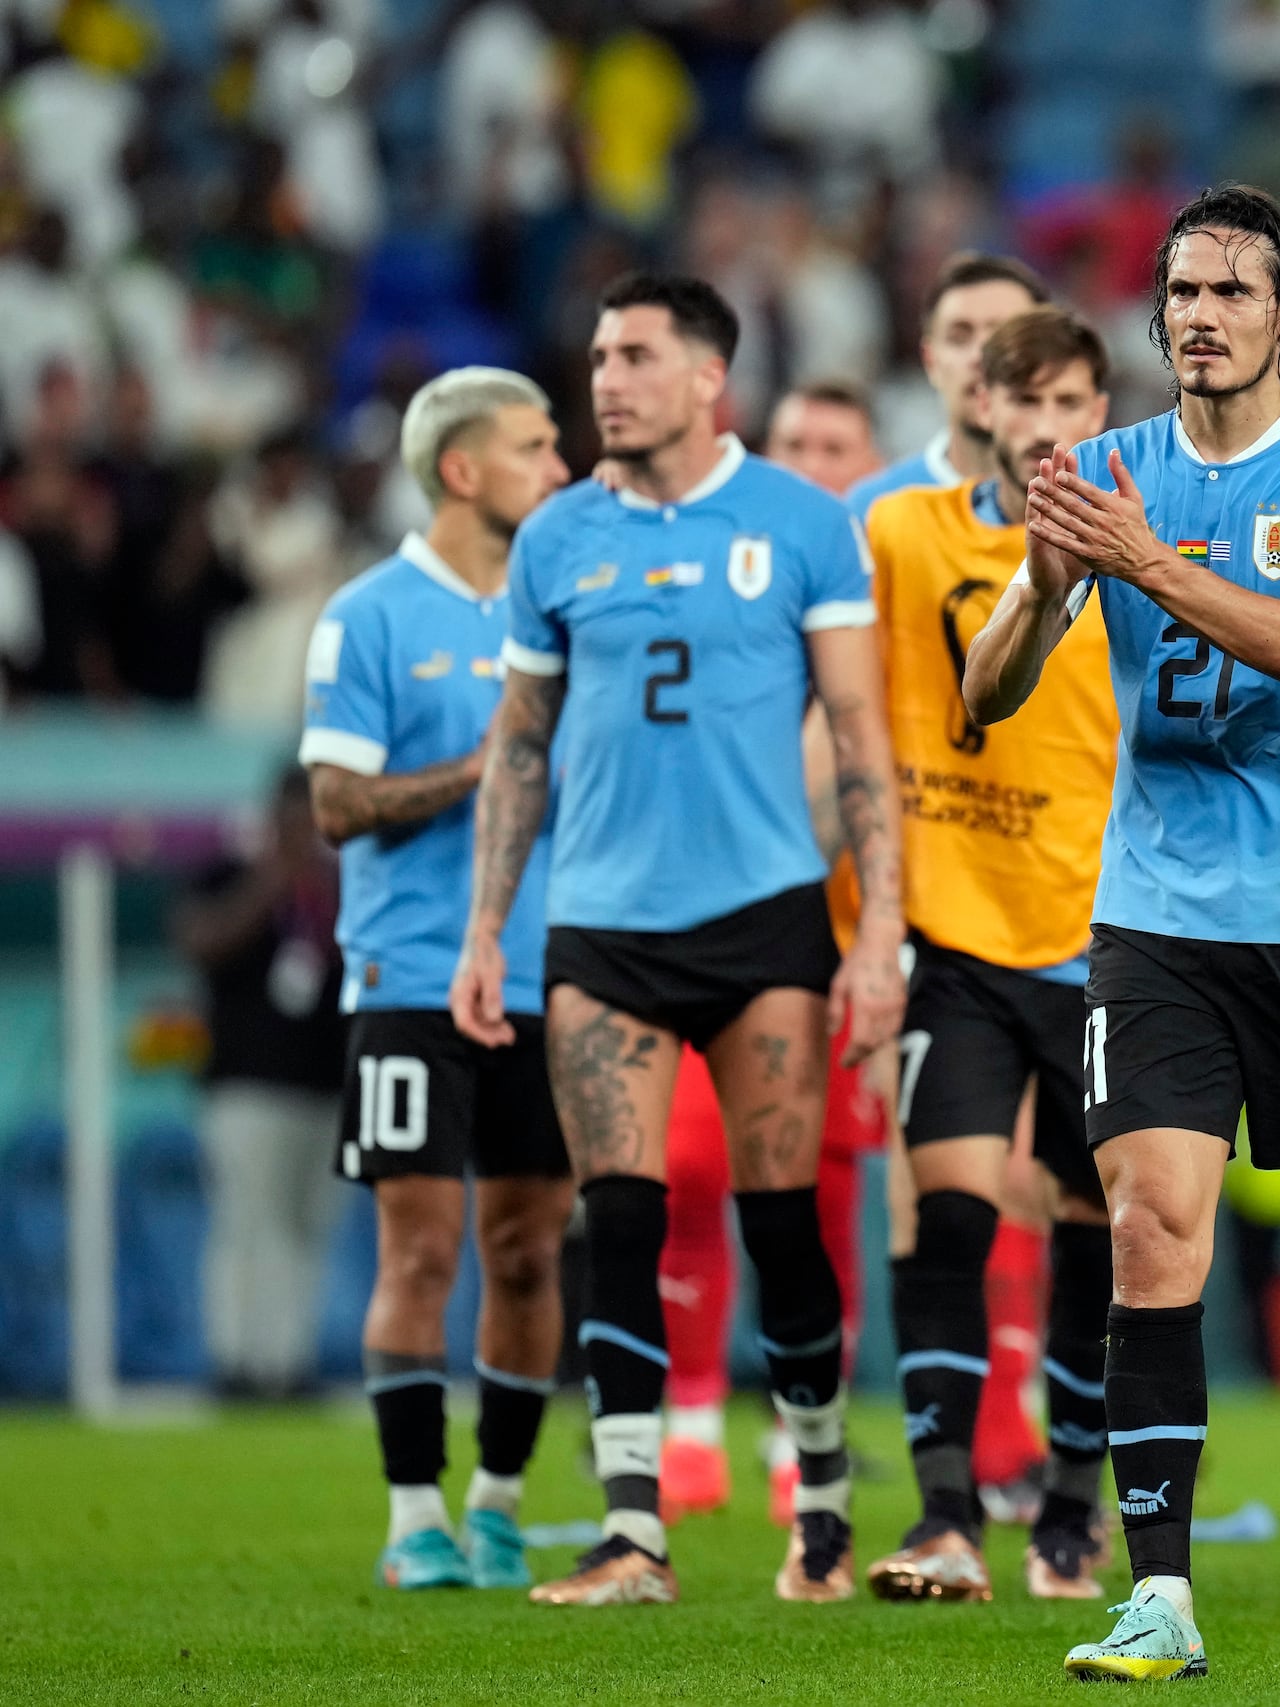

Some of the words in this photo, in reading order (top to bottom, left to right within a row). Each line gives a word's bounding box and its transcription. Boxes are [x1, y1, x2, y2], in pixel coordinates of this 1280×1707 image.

[1268, 526, 1280, 549] AUF
[645, 639, 690, 724] 2
[1157, 622, 1236, 720] 21
[359, 1055, 430, 1151] 10
[898, 1029, 933, 1127] 7
